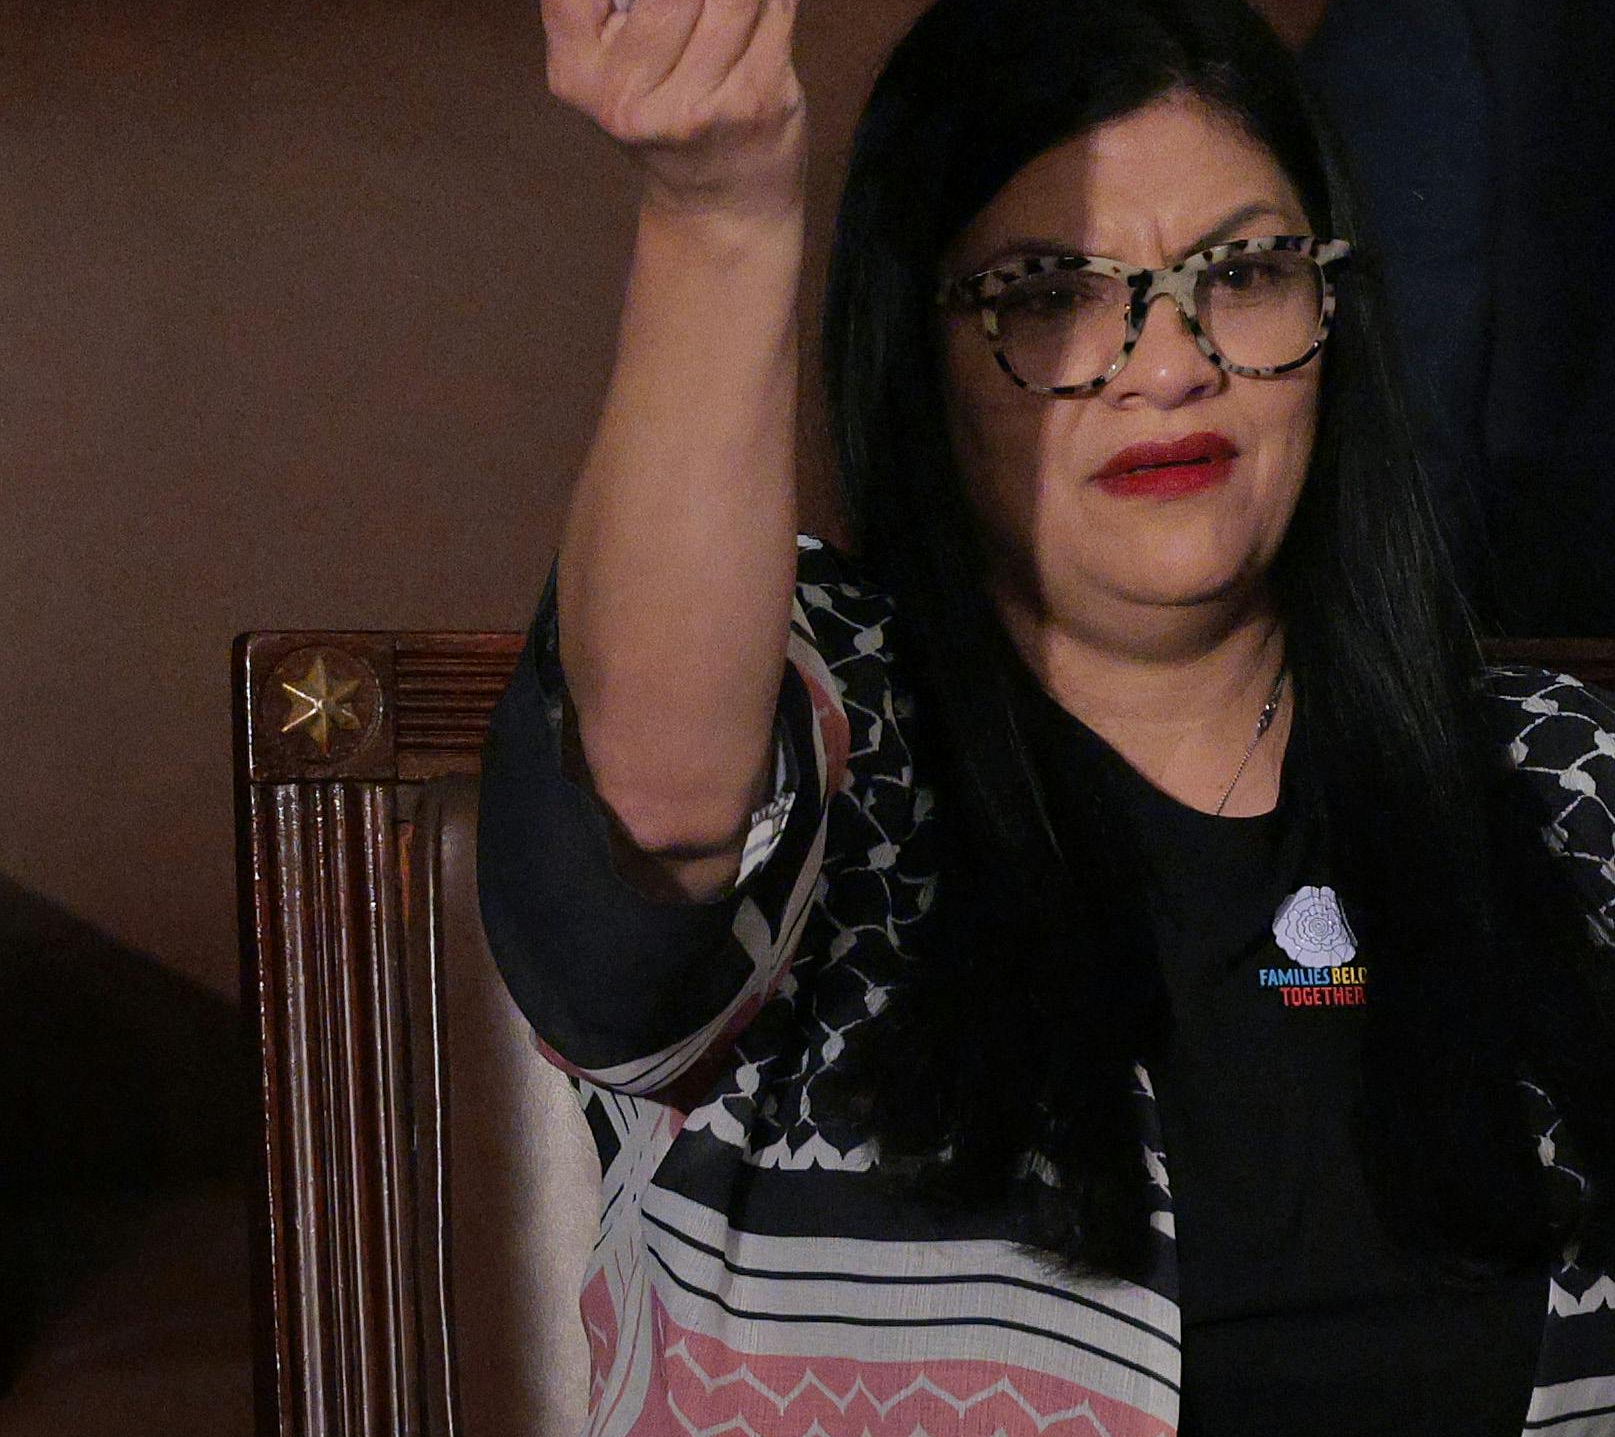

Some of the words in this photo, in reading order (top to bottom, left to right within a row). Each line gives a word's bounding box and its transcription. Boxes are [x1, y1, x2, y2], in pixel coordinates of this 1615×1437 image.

[1258, 968, 1331, 987] FAMILIES
[1331, 967, 1368, 984] BELO
[1279, 986, 1367, 1007] TOGETHER
